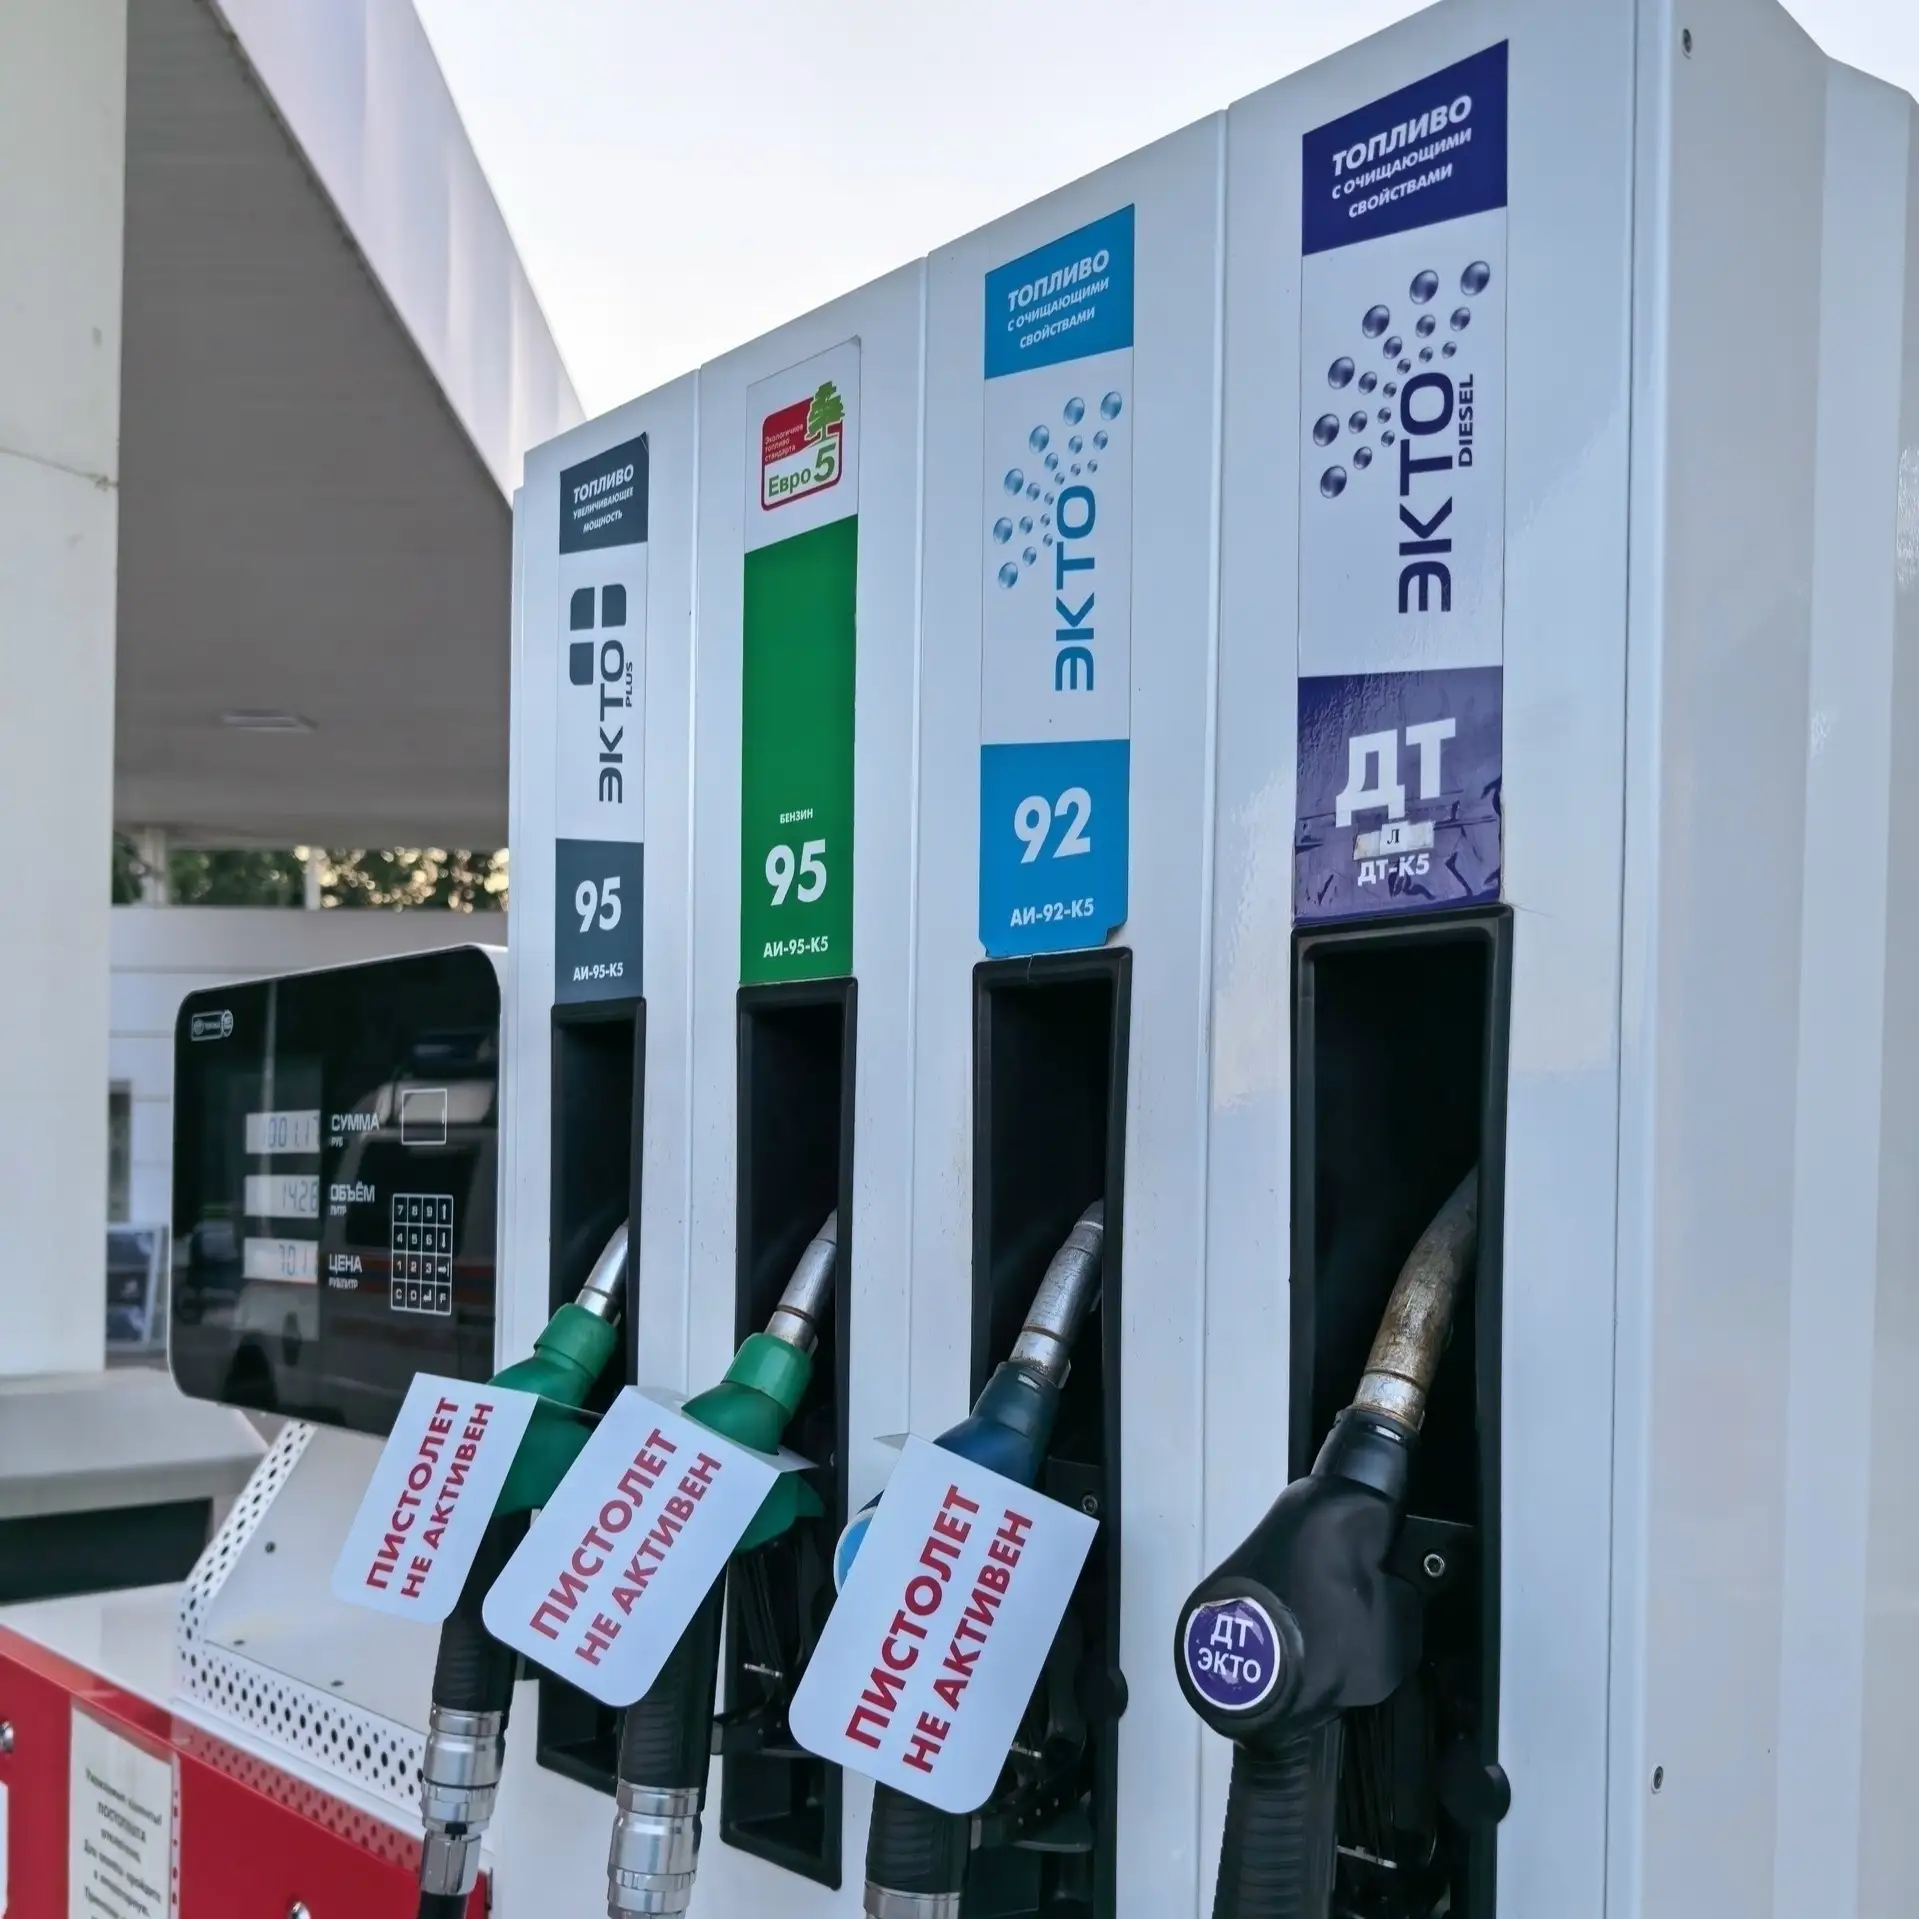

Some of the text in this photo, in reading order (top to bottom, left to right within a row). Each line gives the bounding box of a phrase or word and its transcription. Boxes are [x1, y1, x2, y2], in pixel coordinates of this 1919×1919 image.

[1332, 95, 1473, 177] ТОПЛИВО
[1332, 128, 1472, 200] С ОЧИЩАЮЩИМИ
[1349, 163, 1453, 218] СВОЙСТВАМИ
[1008, 249, 1110, 312] ТОПЛИВО
[1008, 276, 1109, 332] С ОЧИЩАЮЩИМИ
[1020, 306, 1095, 349] СВОЙСТВАМИ
[1459, 373, 1474, 467] DIESEL
[573, 464, 634, 504] ТОПЛИВО
[769, 442, 837, 497] Евро 5
[1399, 372, 1454, 614] ЭКТО
[573, 486, 634, 520] УВЕЛИЧИВАЮЩЕЕ
[583, 509, 623, 534] МОЩНОСТЬ
[1055, 485, 1096, 691] ЭКТО
[625, 660, 633, 707] PLUS
[599, 639, 625, 803] ЭКТО
[1336, 717, 1456, 829] ДТ
[780, 808, 813, 824] БЕНЗИН
[1014, 786, 1092, 864] 92
[1387, 828, 1400, 844] Л
[765, 838, 827, 906] 95
[1357, 853, 1430, 886] ДТ-К5
[574, 875, 623, 933] 95
[1010, 898, 1095, 927] АИ-92-К5
[572, 962, 624, 982] АИ-95-К5
[763, 935, 829, 958] АИ-95-К5
[331, 1113, 380, 1132] СУММА
[330, 1181, 375, 1203] ОБЪЁМ
[397, 1205, 433, 1218] 7 8 9
[329, 1253, 363, 1275] ЦЕНА
[397, 1233, 433, 1246] 4 5 6
[397, 1260, 432, 1274] 1 2 3
[366, 1396, 460, 1590] ПИСТОЛЕТ
[400, 1402, 494, 1599] НЕ АКТИВЕН
[529, 1428, 677, 1640] ПИСТОЛЕТ
[574, 1452, 723, 1667] НЕ АКТИВЕН
[845, 1484, 980, 1750] ПИСТОЛЕТ
[902, 1509, 1034, 1774] НЕ АКТИВЕН
[1210, 1613, 1254, 1650] ДТ
[1197, 1647, 1261, 1684] ЭКТО
